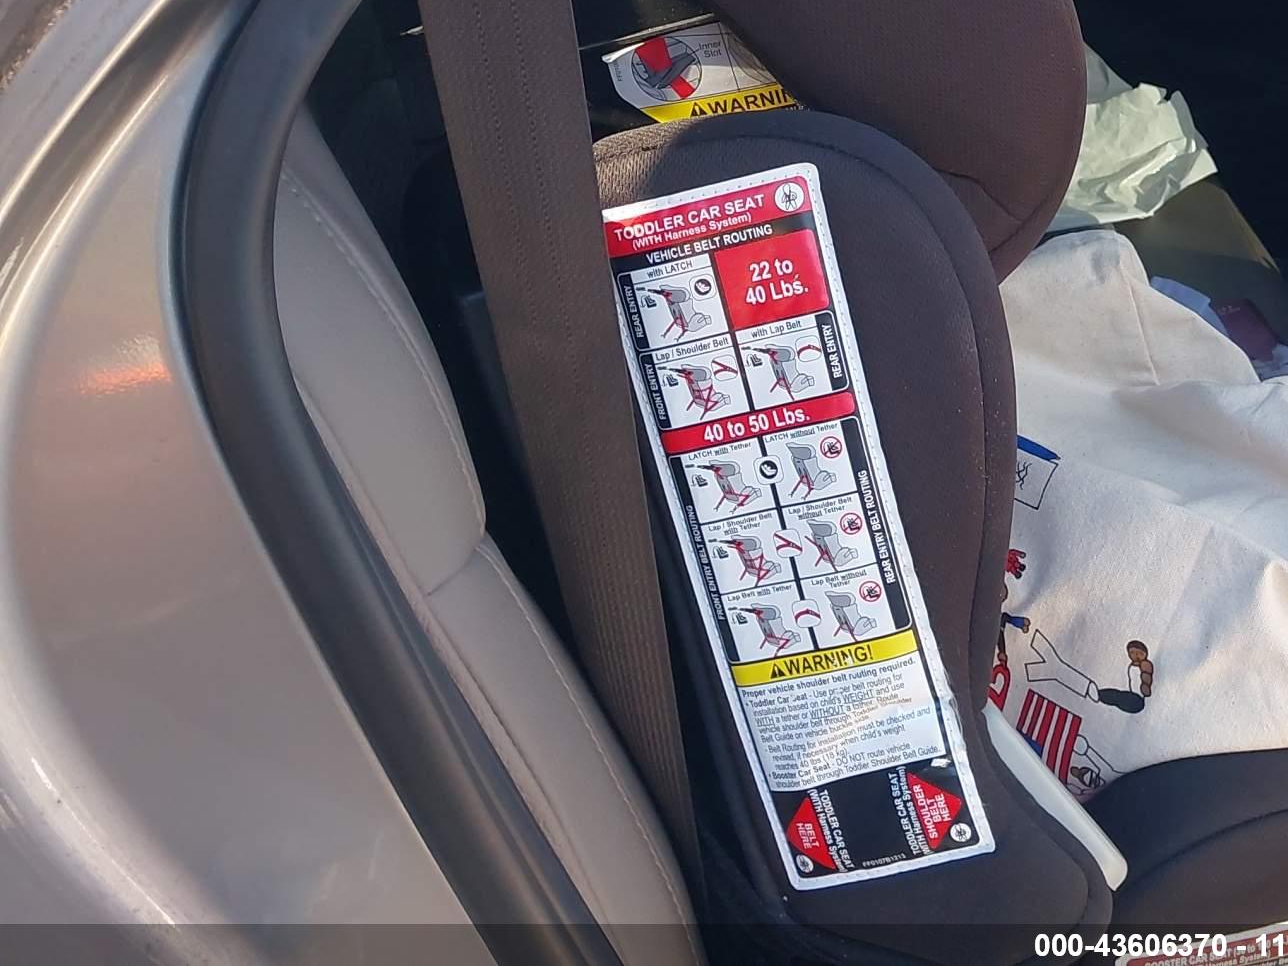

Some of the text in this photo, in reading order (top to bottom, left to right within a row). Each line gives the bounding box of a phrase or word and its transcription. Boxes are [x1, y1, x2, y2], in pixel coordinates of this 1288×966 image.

[614, 193, 766, 242] TODDLER CAR SEAT
[631, 211, 752, 250] (WITH Harness System)
[645, 223, 773, 264] VEHICLE BELT ROUTING
[646, 260, 693, 278] with LATCH
[748, 254, 793, 282] 22 to
[743, 274, 809, 306] 40 Lbs.
[623, 283, 644, 339] REAR ENTRY
[750, 319, 801, 338] with Lap Belt
[655, 350, 670, 361] Lap
[675, 340, 711, 356] Shoulder
[712, 336, 729, 347] Belt
[822, 322, 842, 379] REAR ENTRY
[644, 362, 667, 421] FRONT ENTRY
[701, 403, 810, 444] 40 to 50 Lbs.
[764, 433, 789, 444] LATCH
[688, 450, 712, 461] LATCH
[685, 504, 701, 542] ROUTING
[857, 469, 895, 584] REAR ENTRY BELT ROUTING
[741, 685, 766, 701] Proper
[767, 681, 795, 696] vehicle
[795, 674, 830, 691] shoulder
[831, 672, 847, 683] belt
[877, 656, 916, 674] required.
[784, 642, 873, 679] WARNING!
[748, 694, 775, 710] Toddler
[776, 694, 790, 705] Car
[887, 772, 921, 855] TODDLER CAR SEAT
[912, 784, 938, 839] SHOULDER
[926, 797, 942, 823] BELT
[934, 793, 951, 822] HERE
[796, 822, 811, 850] HERE
[803, 822, 819, 848] BELT
[818, 789, 855, 870] TODDLER CAR SEAT
